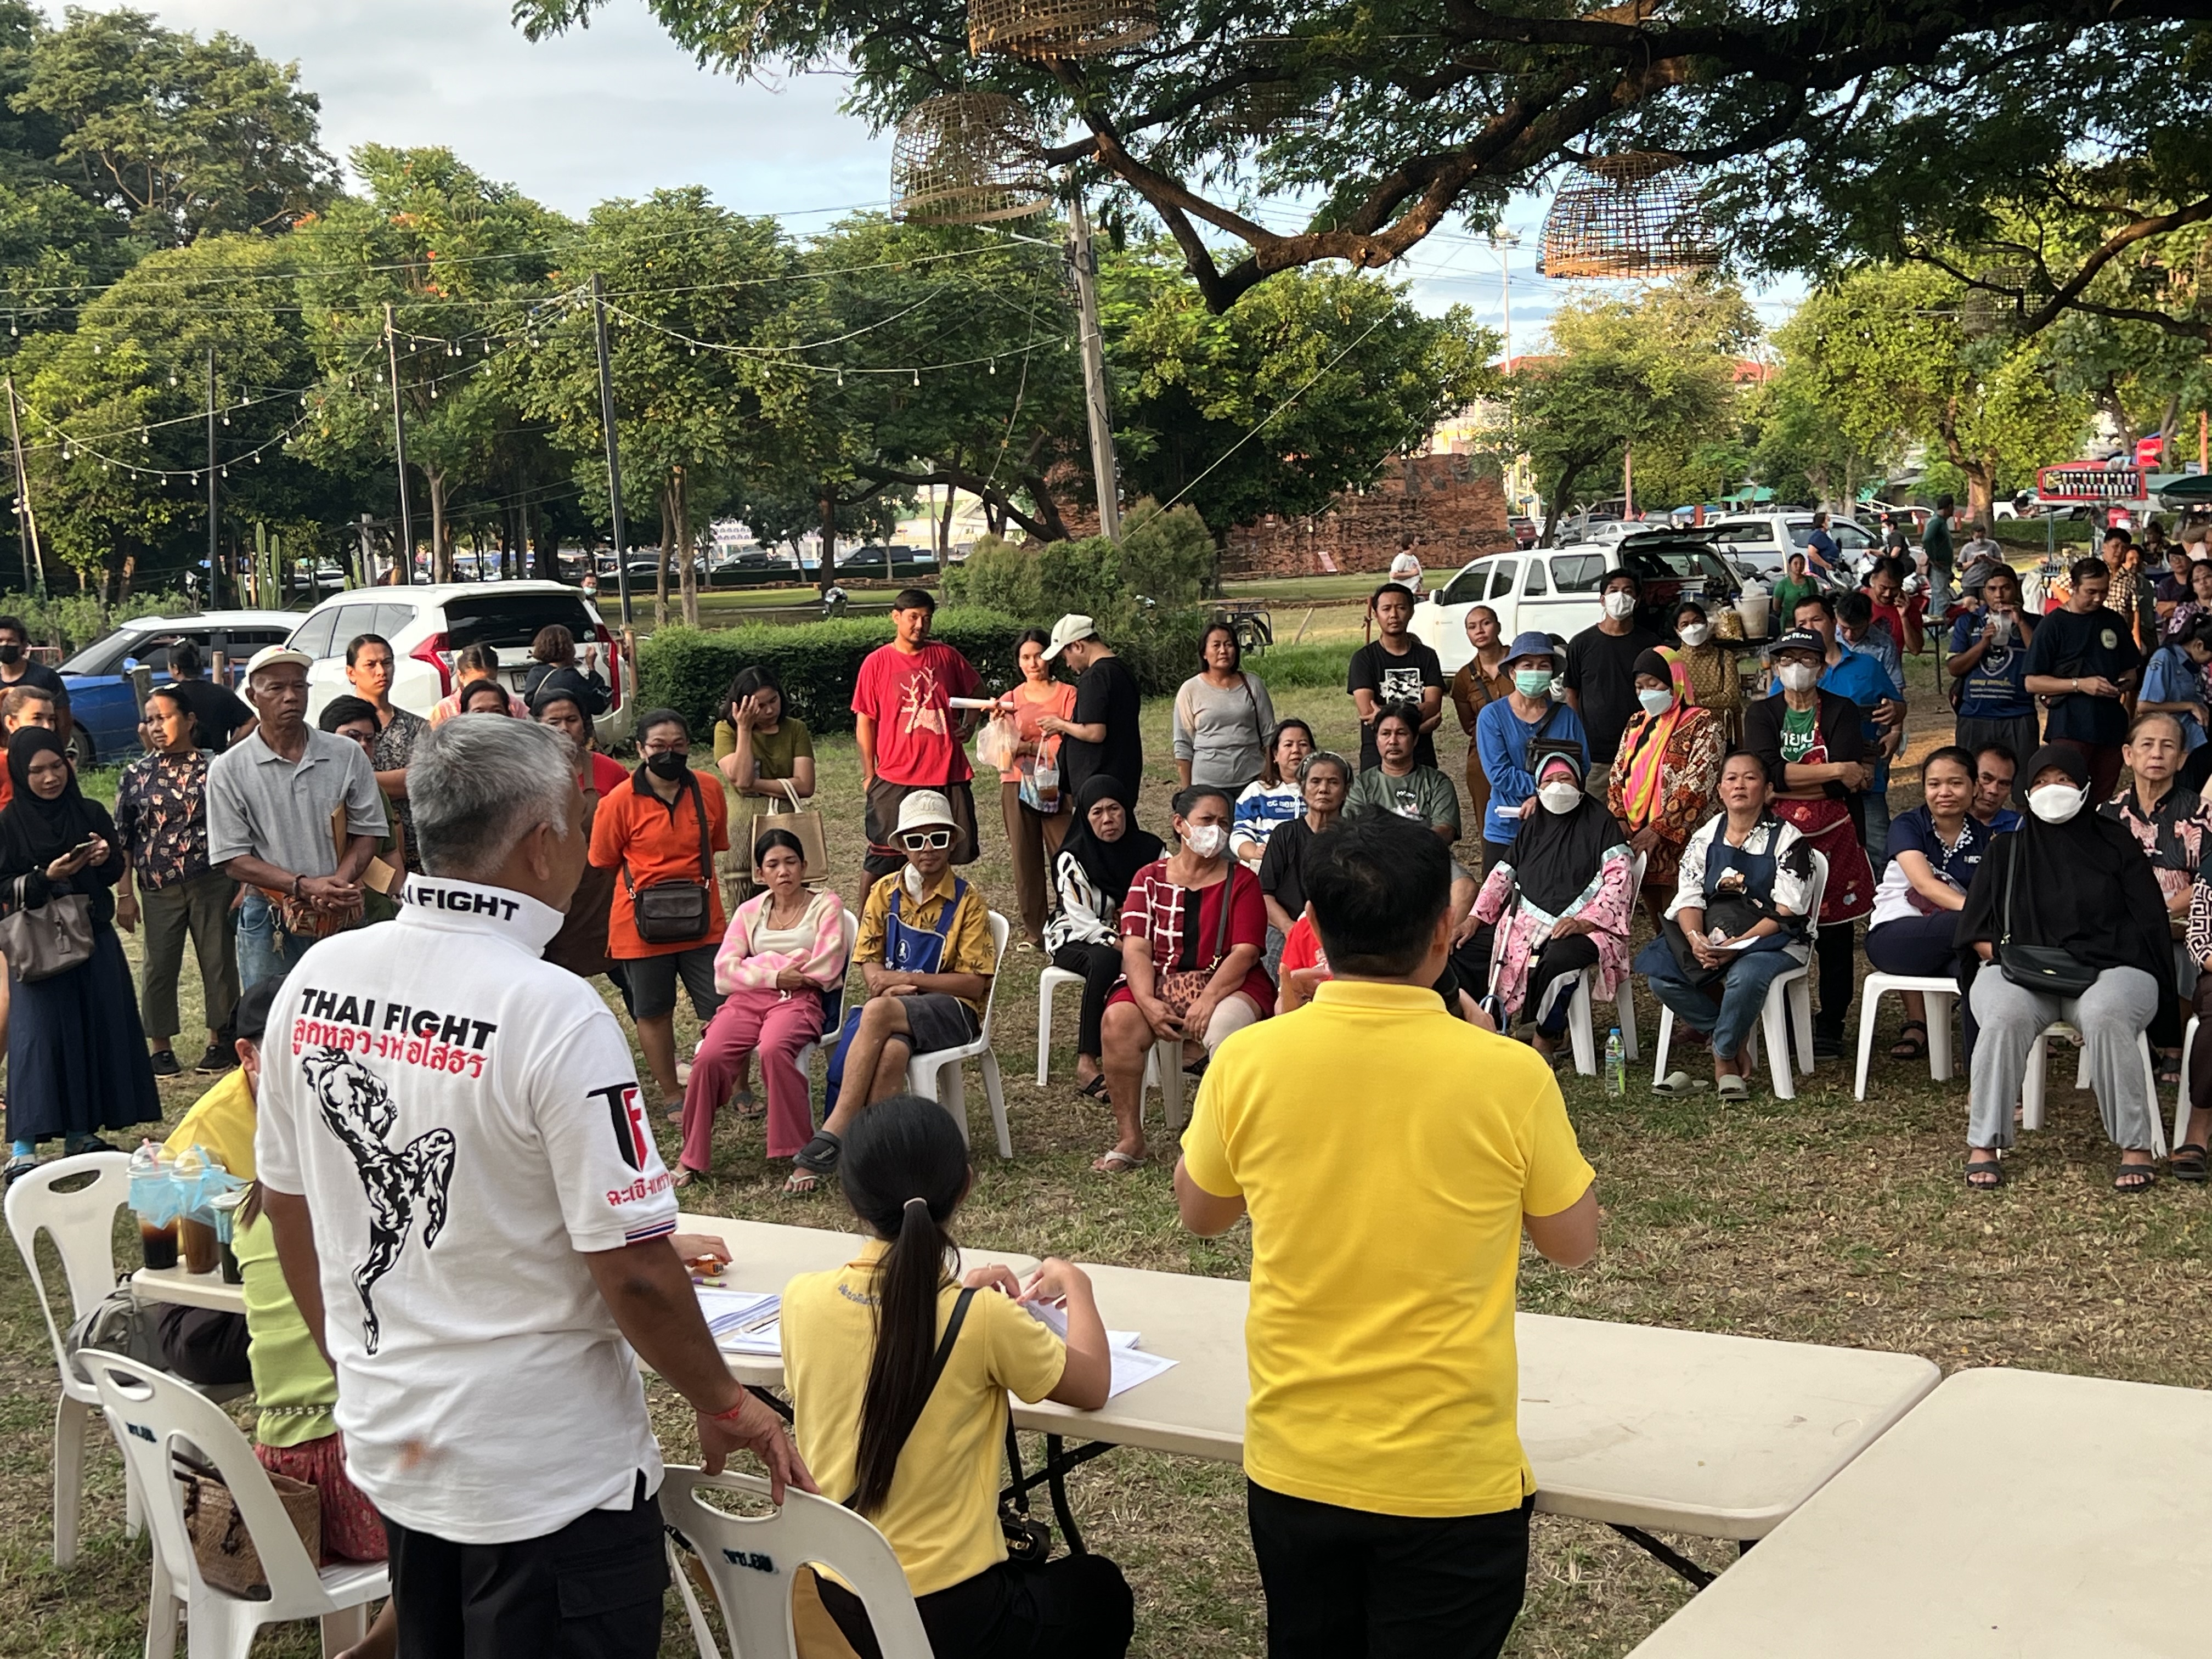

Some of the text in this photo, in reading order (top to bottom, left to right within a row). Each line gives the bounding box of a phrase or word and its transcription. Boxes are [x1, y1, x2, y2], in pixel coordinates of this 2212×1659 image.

[417, 887, 520, 921] FIGHT
[292, 1018, 488, 1079] ลูกหลวงพ่อโสธร
[301, 988, 498, 1050] THAI FIGHT
